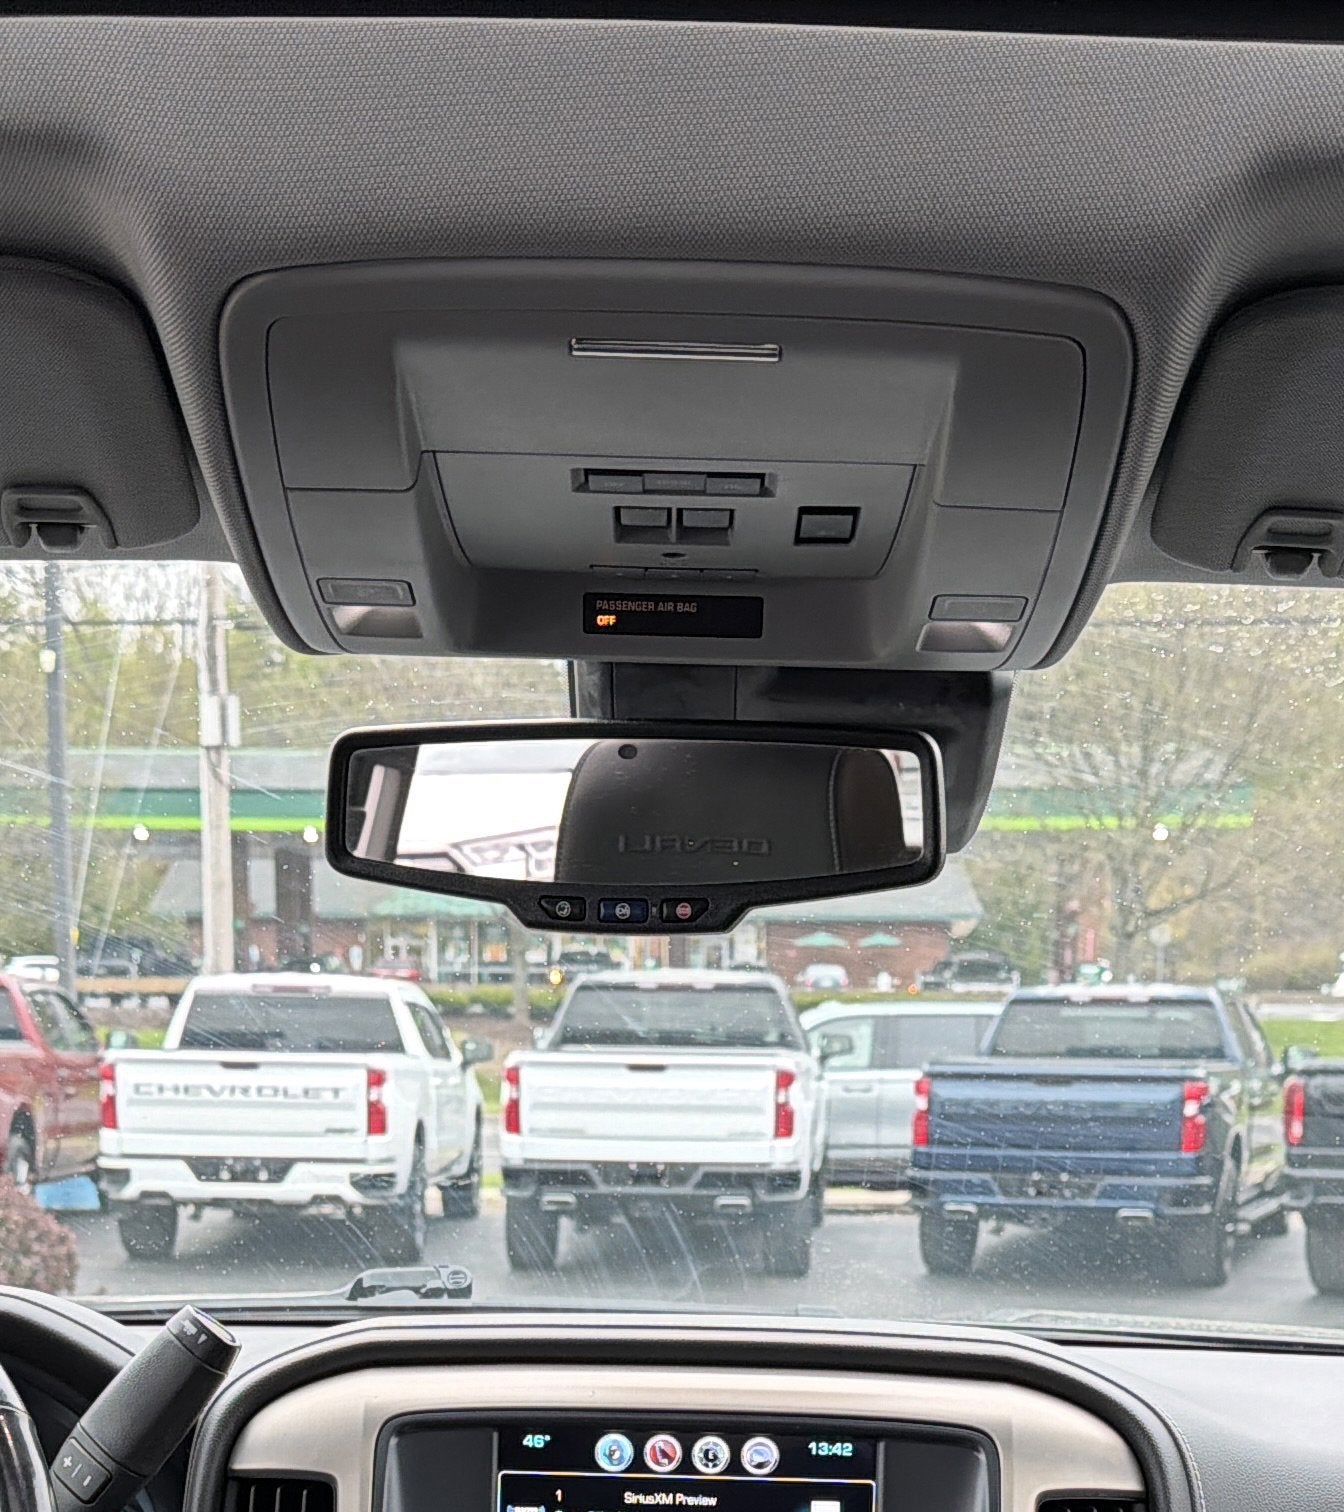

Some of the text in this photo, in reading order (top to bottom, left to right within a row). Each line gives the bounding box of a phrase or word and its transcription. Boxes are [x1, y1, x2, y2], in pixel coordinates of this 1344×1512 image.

[596, 600, 697, 613] PASSENGER AIR BAG
[596, 614, 617, 626] OFF
[133, 1082, 346, 1100] CHEVROLET
[808, 1441, 853, 1457] 13:42
[555, 1489, 718, 1507] 1 SiriusXM Preview
